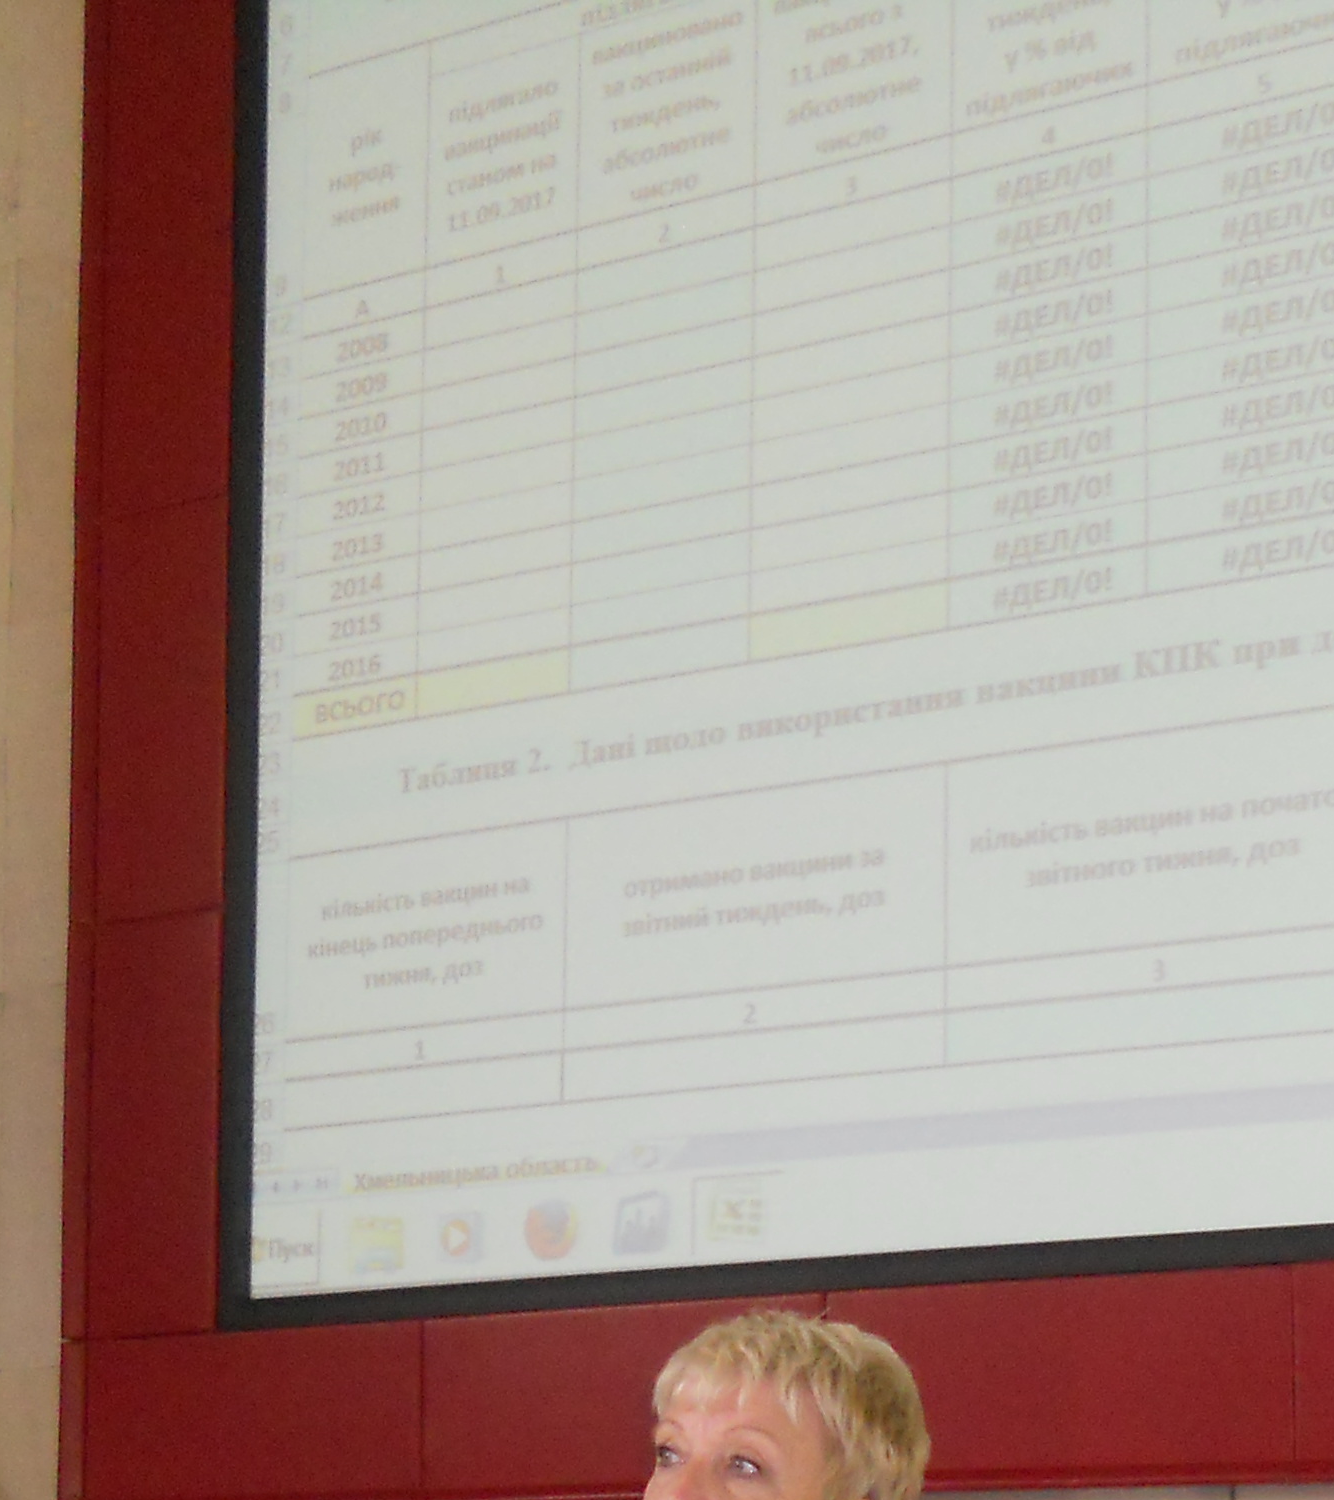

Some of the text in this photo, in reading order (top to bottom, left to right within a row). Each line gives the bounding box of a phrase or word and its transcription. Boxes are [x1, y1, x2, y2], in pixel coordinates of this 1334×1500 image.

[333, 411, 388, 442] 2010
[332, 451, 386, 481] 2011
[331, 492, 386, 521] 2012
[330, 532, 385, 562] 2013
[328, 571, 383, 602] 2014
[327, 611, 383, 641] 2015
[327, 653, 382, 682] 2016
[315, 689, 407, 725] ВСЬОГО
[398, 757, 519, 795] Таблиця
[567, 733, 637, 772] Дані
[643, 723, 728, 760] щодо
[736, 687, 966, 744] використання
[975, 662, 1122, 706] вакцини
[1132, 637, 1224, 681] КПК
[1233, 634, 1302, 674] при
[968, 820, 1089, 855] кількість
[1093, 807, 1194, 840] вакцин
[1199, 801, 1234, 826] на
[623, 846, 887, 900] отримано вакцини за
[1024, 857, 1137, 890] звітного
[1245, 836, 1302, 868] доз
[320, 891, 416, 922] кількість
[419, 879, 500, 908] вакцин
[836, 886, 887, 917] доз
[307, 911, 546, 960] кінець попереднього
[441, 958, 485, 986] доз
[1152, 957, 1167, 982] 3
[742, 1002, 758, 1026] 2
[413, 1038, 427, 1061] 1
